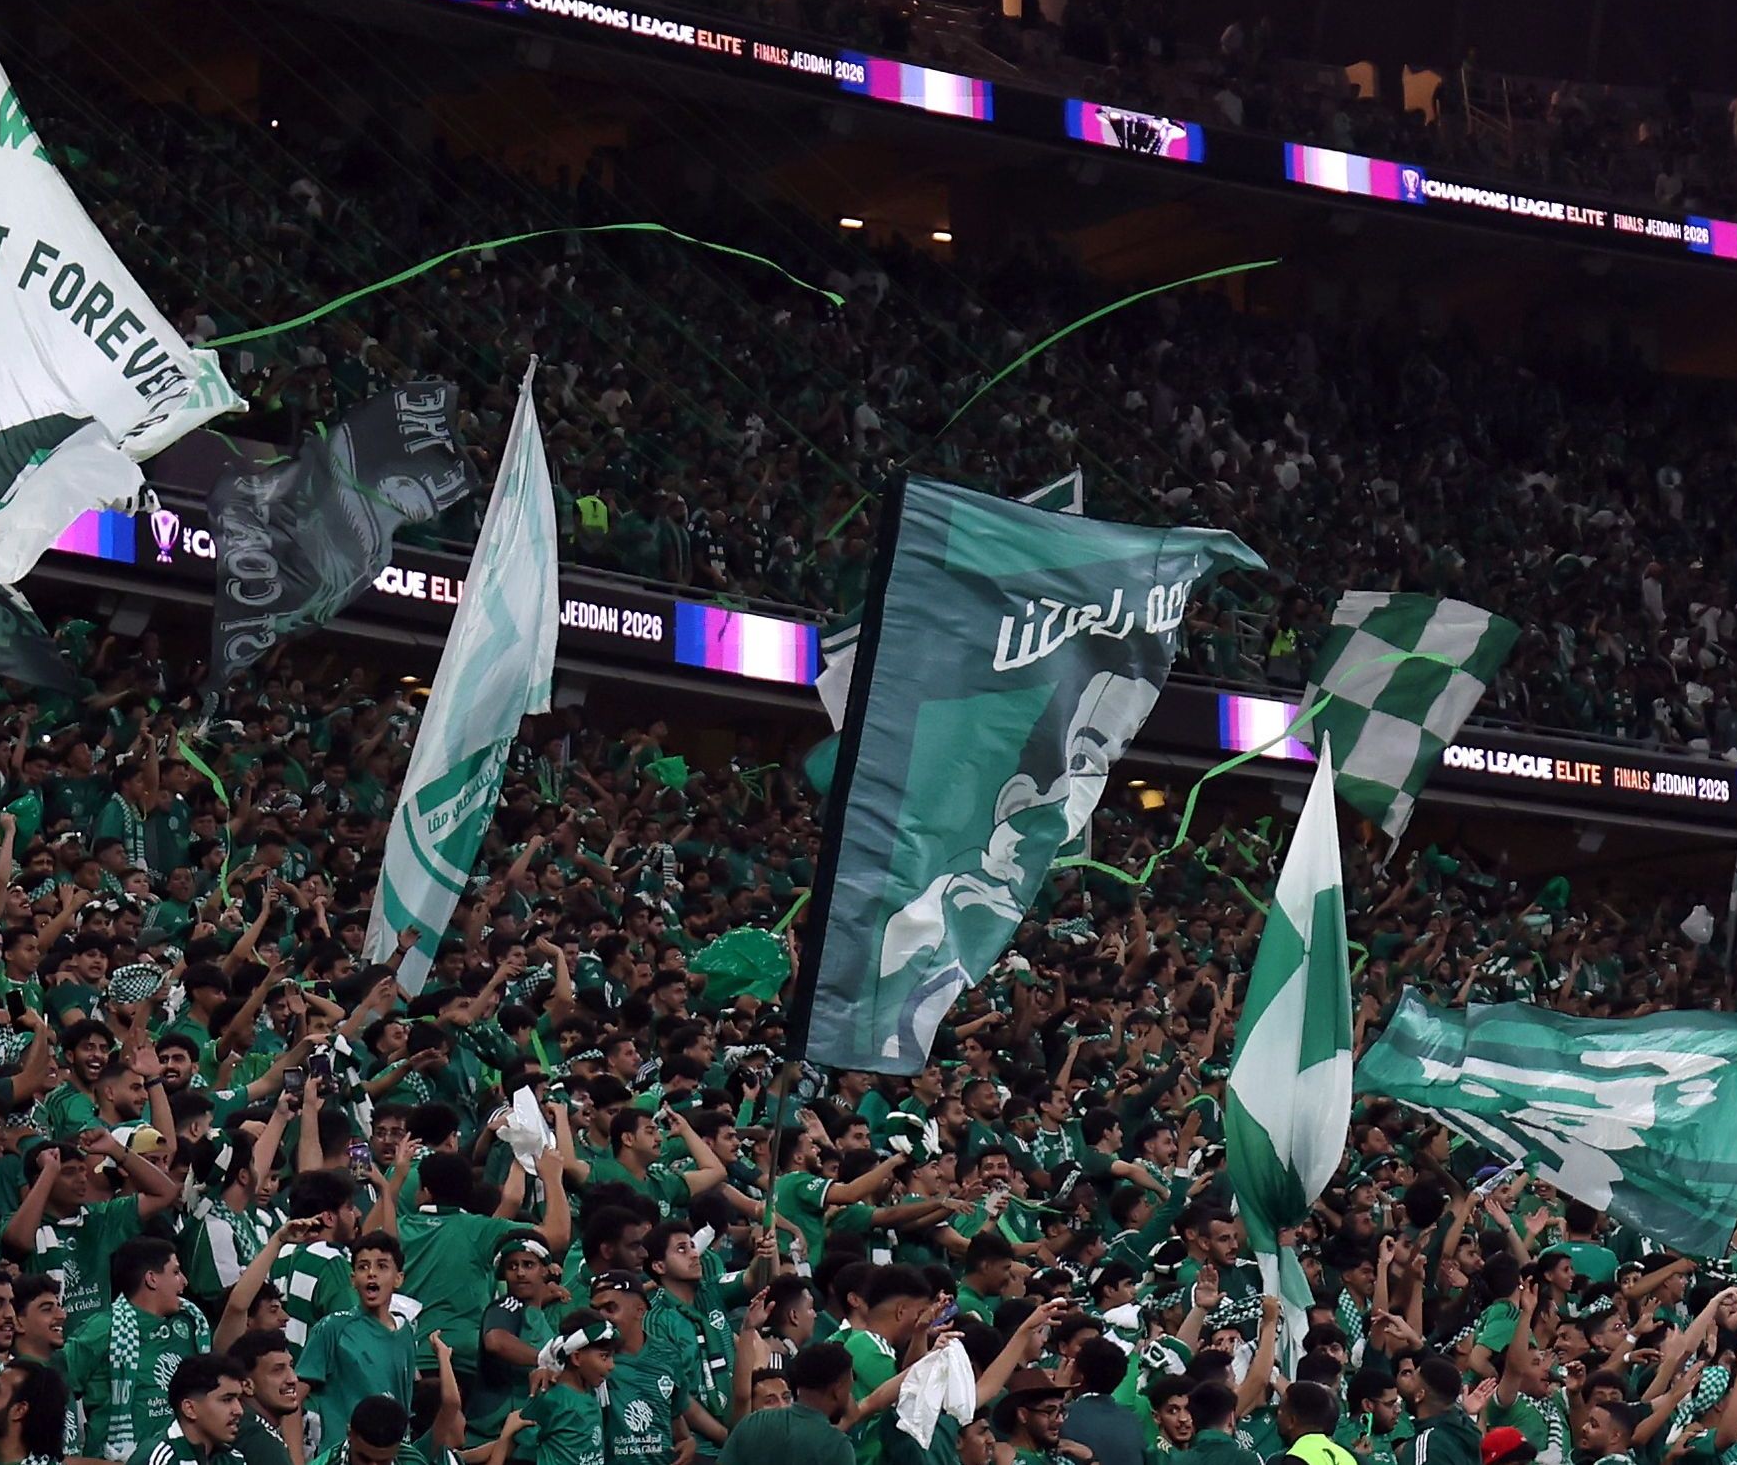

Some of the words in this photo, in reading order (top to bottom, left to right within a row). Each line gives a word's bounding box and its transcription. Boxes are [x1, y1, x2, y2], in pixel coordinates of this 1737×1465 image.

[631, 14, 695, 45] LEAGUE
[697, 29, 743, 56] ELITE
[753, 42, 788, 66] FINALS
[790, 50, 832, 76] JEDDAH
[834, 60, 865, 83] 2026
[1426, 179, 1509, 211] CHAMPIONS
[1510, 194, 1564, 219] LEAGUE
[1614, 212, 1644, 233] FINALS
[1645, 217, 1681, 239] JEDDAH
[1683, 224, 1709, 244] 2026
[560, 609, 619, 635] JEDDAH
[622, 611, 663, 642] 2026
[1487, 750, 1553, 779] LEAGUE
[1556, 760, 1602, 784] ELITE
[1614, 767, 1650, 791] FINALS
[1652, 772, 1696, 797] JEDDAH
[1699, 777, 1730, 802] 2026
